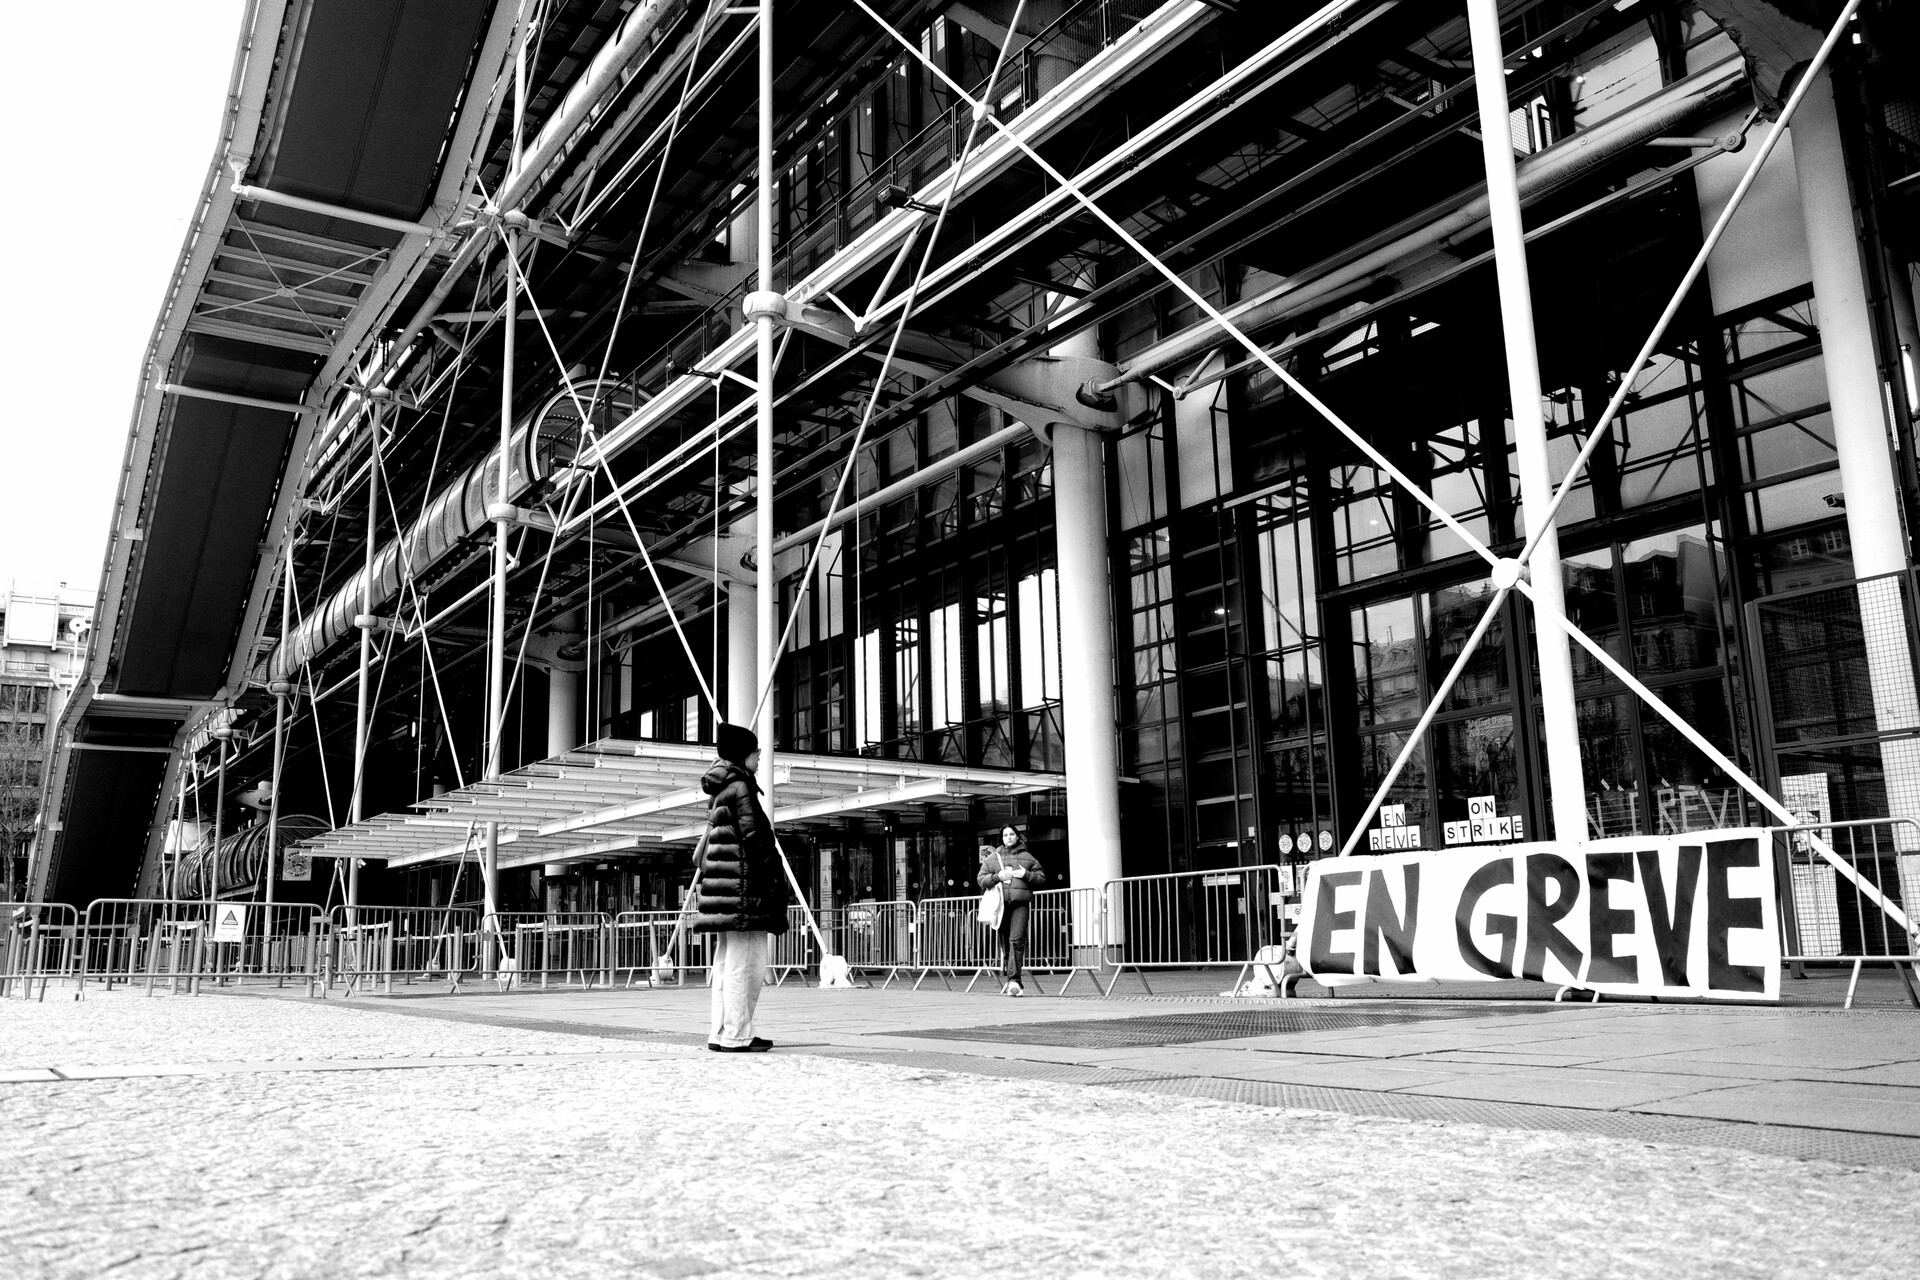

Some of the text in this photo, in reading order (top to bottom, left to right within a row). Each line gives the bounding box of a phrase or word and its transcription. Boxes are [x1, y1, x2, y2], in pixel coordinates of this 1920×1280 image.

[1470, 800, 1494, 814] ON
[1383, 811, 1405, 827] EN
[1446, 820, 1523, 839] STRIKE
[1372, 833, 1418, 849] REVE
[1310, 837, 1766, 994] EN GREVE
